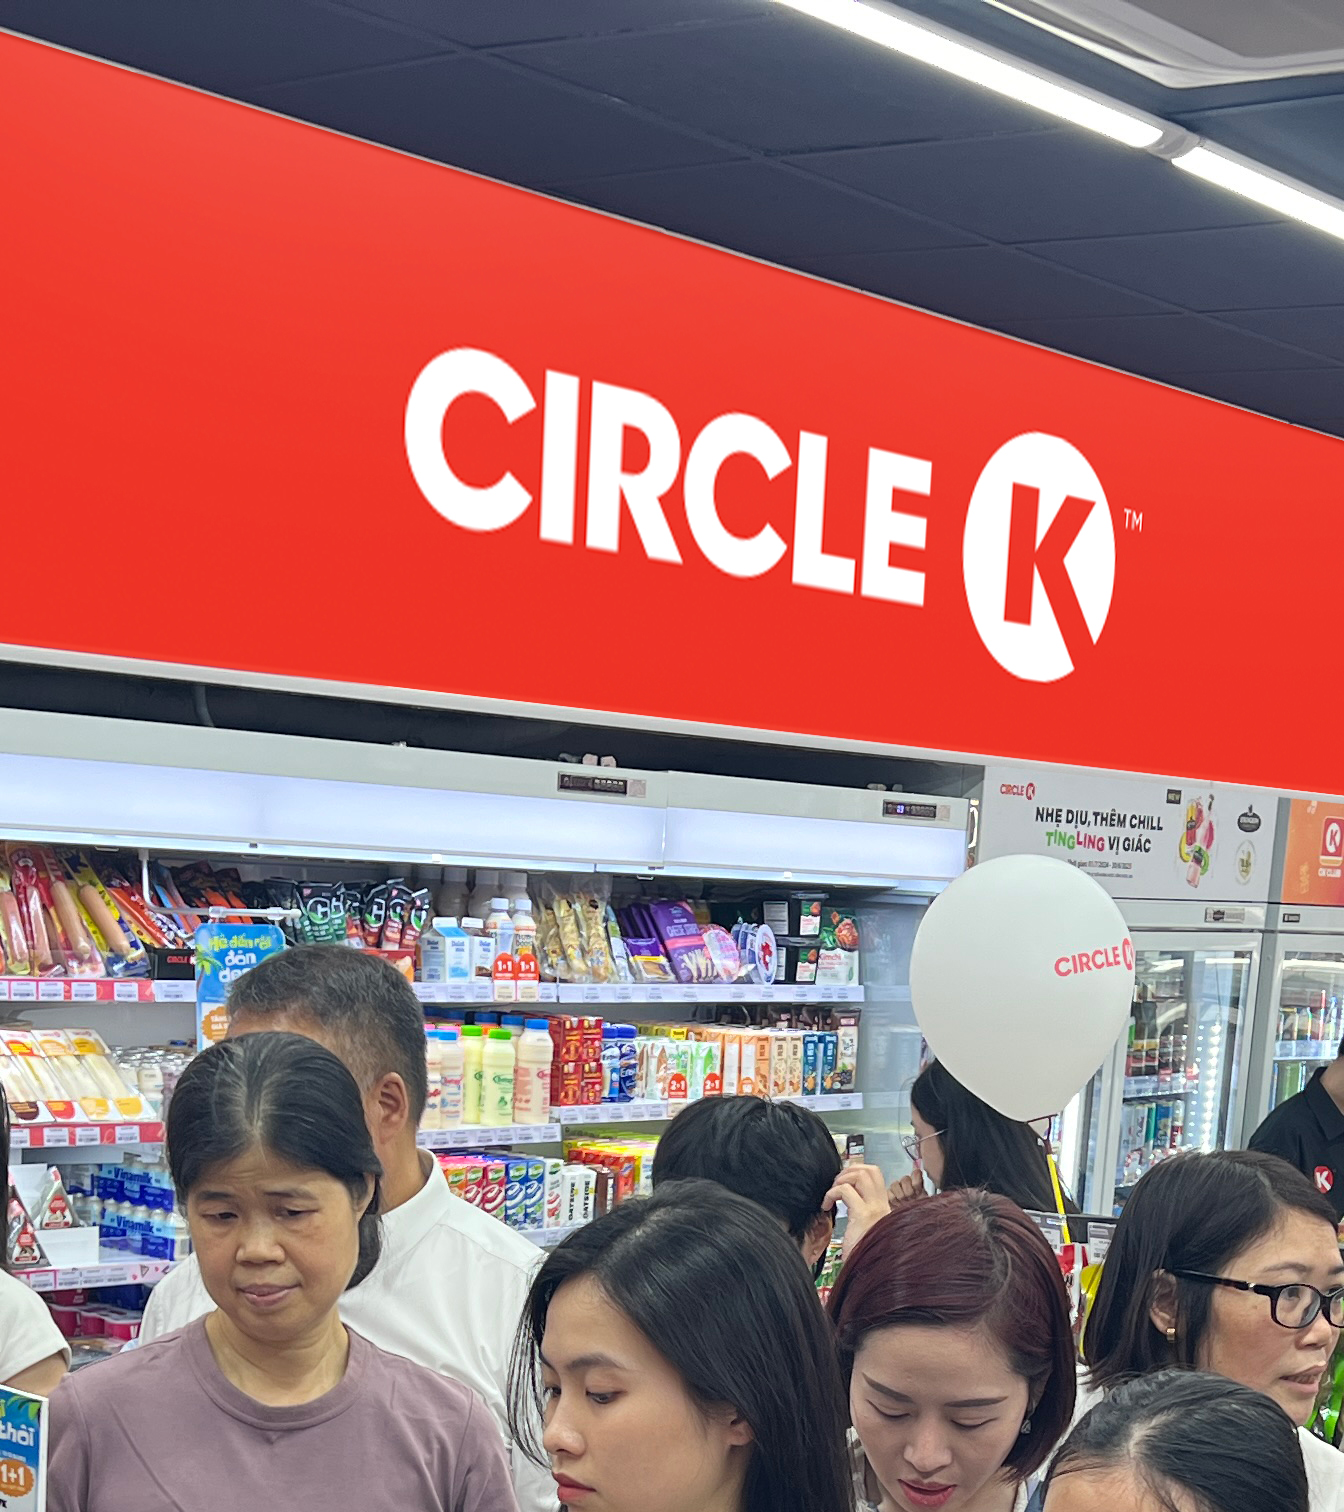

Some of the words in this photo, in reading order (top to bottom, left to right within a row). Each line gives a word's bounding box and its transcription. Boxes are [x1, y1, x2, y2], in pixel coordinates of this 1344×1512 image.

[404, 347, 932, 606] CIRCLE
[962, 431, 1115, 682] K
[1000, 784, 1024, 796] CIRCLE
[1025, 782, 1035, 800] K
[1035, 807, 1062, 826] NHẸ
[1065, 810, 1091, 829] DỊU,
[1093, 808, 1126, 829] THÊM
[1129, 814, 1163, 831] CHILL
[1108, 836, 1120, 856] VỊ
[1122, 833, 1152, 853] GIÁC
[225, 949, 257, 966] đón
[1054, 946, 1120, 976] CIRCLE
[1315, 1167, 1333, 1193] K
[0, 1463, 25, 1486] 1+1
